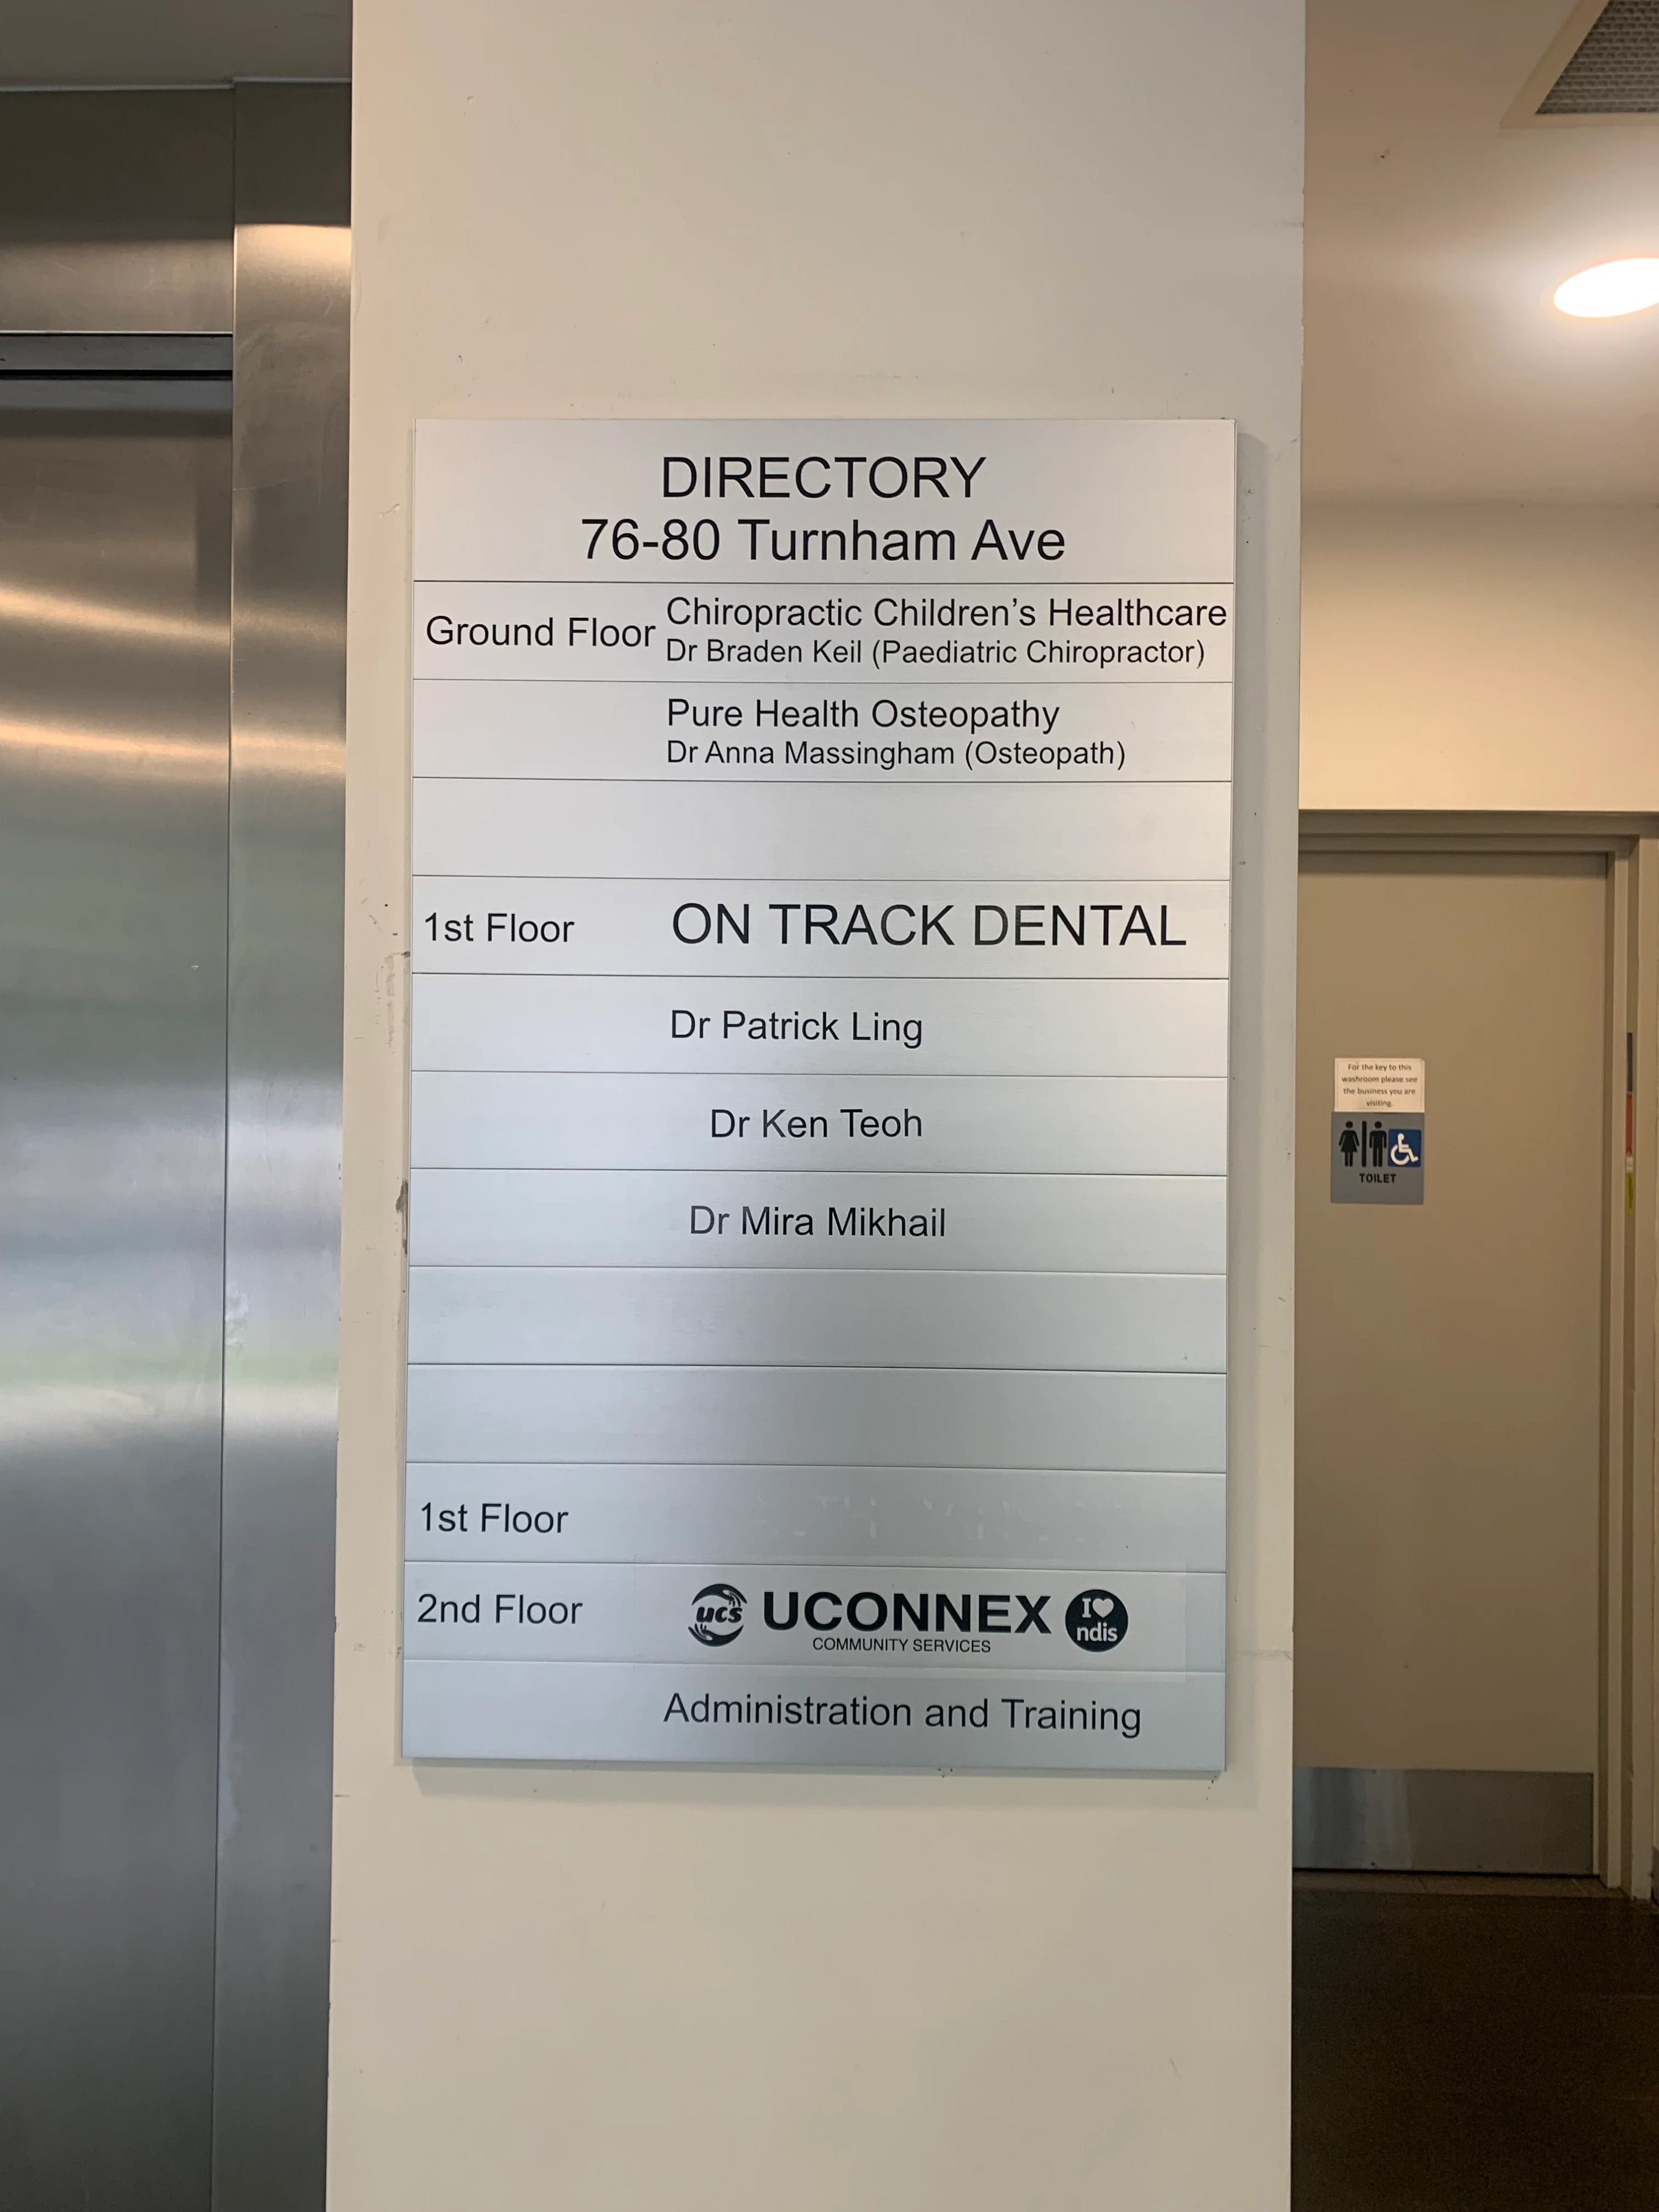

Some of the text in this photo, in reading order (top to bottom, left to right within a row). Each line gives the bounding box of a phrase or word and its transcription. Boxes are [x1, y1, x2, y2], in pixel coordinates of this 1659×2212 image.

[663, 456, 987, 499] DIRECTORY
[582, 518, 1065, 561] 76-80 Turnham Ave
[667, 597, 1227, 633] Chiropractic Children’s Healthcare
[426, 615, 656, 647] Ground Floor
[667, 638, 1204, 670] Dr Braden Keil (Paediatric Chiropractor)
[669, 698, 1060, 735] Pure Health Osteopathy
[668, 740, 1125, 771] Dr Anna Massingham (Osteopath)
[425, 912, 575, 942] 1st Floor
[672, 902, 1187, 946] ON TRACK DENTAL
[672, 1010, 922, 1049] Dr Patrick Ling
[1375, 1063, 1387, 1072] key
[1381, 1076, 1404, 1084] please
[712, 1108, 922, 1138] Dr Ken Teoh
[1359, 1173, 1396, 1183] TOILET
[691, 1206, 945, 1237] Dr Mira Mikhail
[421, 1502, 569, 1533] 1st Floor
[418, 1593, 583, 1624] 2nd Floor
[696, 1605, 743, 1624] ucs
[764, 1592, 1052, 1634] UCONNEX
[813, 1637, 991, 1653] COMMUNITY SERVICES
[1077, 1623, 1118, 1643] ndis
[664, 1693, 1140, 1739] Administration and Training
